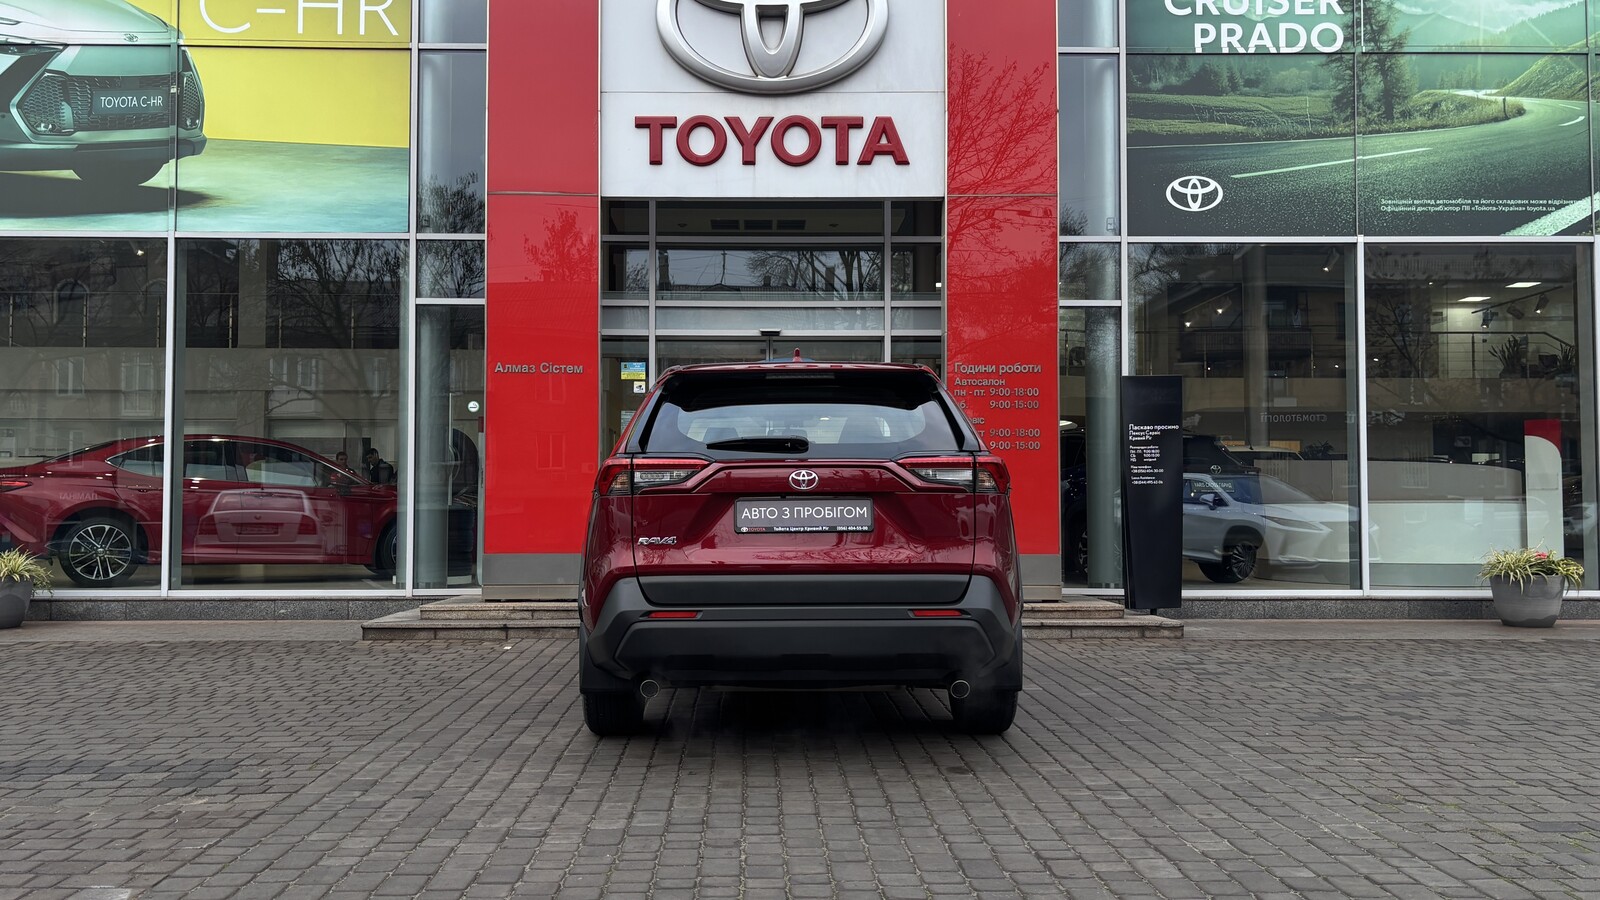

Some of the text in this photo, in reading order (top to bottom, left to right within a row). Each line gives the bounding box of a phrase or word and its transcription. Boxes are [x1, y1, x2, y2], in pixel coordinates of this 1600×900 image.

[1194, 22, 1344, 54] PRADO
[100, 96, 163, 108] TOYOTA C-HR
[634, 115, 910, 167] TOYOTA
[494, 362, 584, 374] Алмаз Сістем
[954, 363, 1042, 375] Години роботи
[954, 378, 1006, 386] Автосалон
[990, 388, 1040, 396] 9:00-18:00
[990, 400, 1040, 409] 9:00-15:00
[990, 429, 1040, 437] 9:00-18:00
[990, 442, 1040, 450] 9:00-15:00
[741, 506, 868, 519] АВТО З ПРОБІГОМ
[638, 536, 677, 545] RAV4
